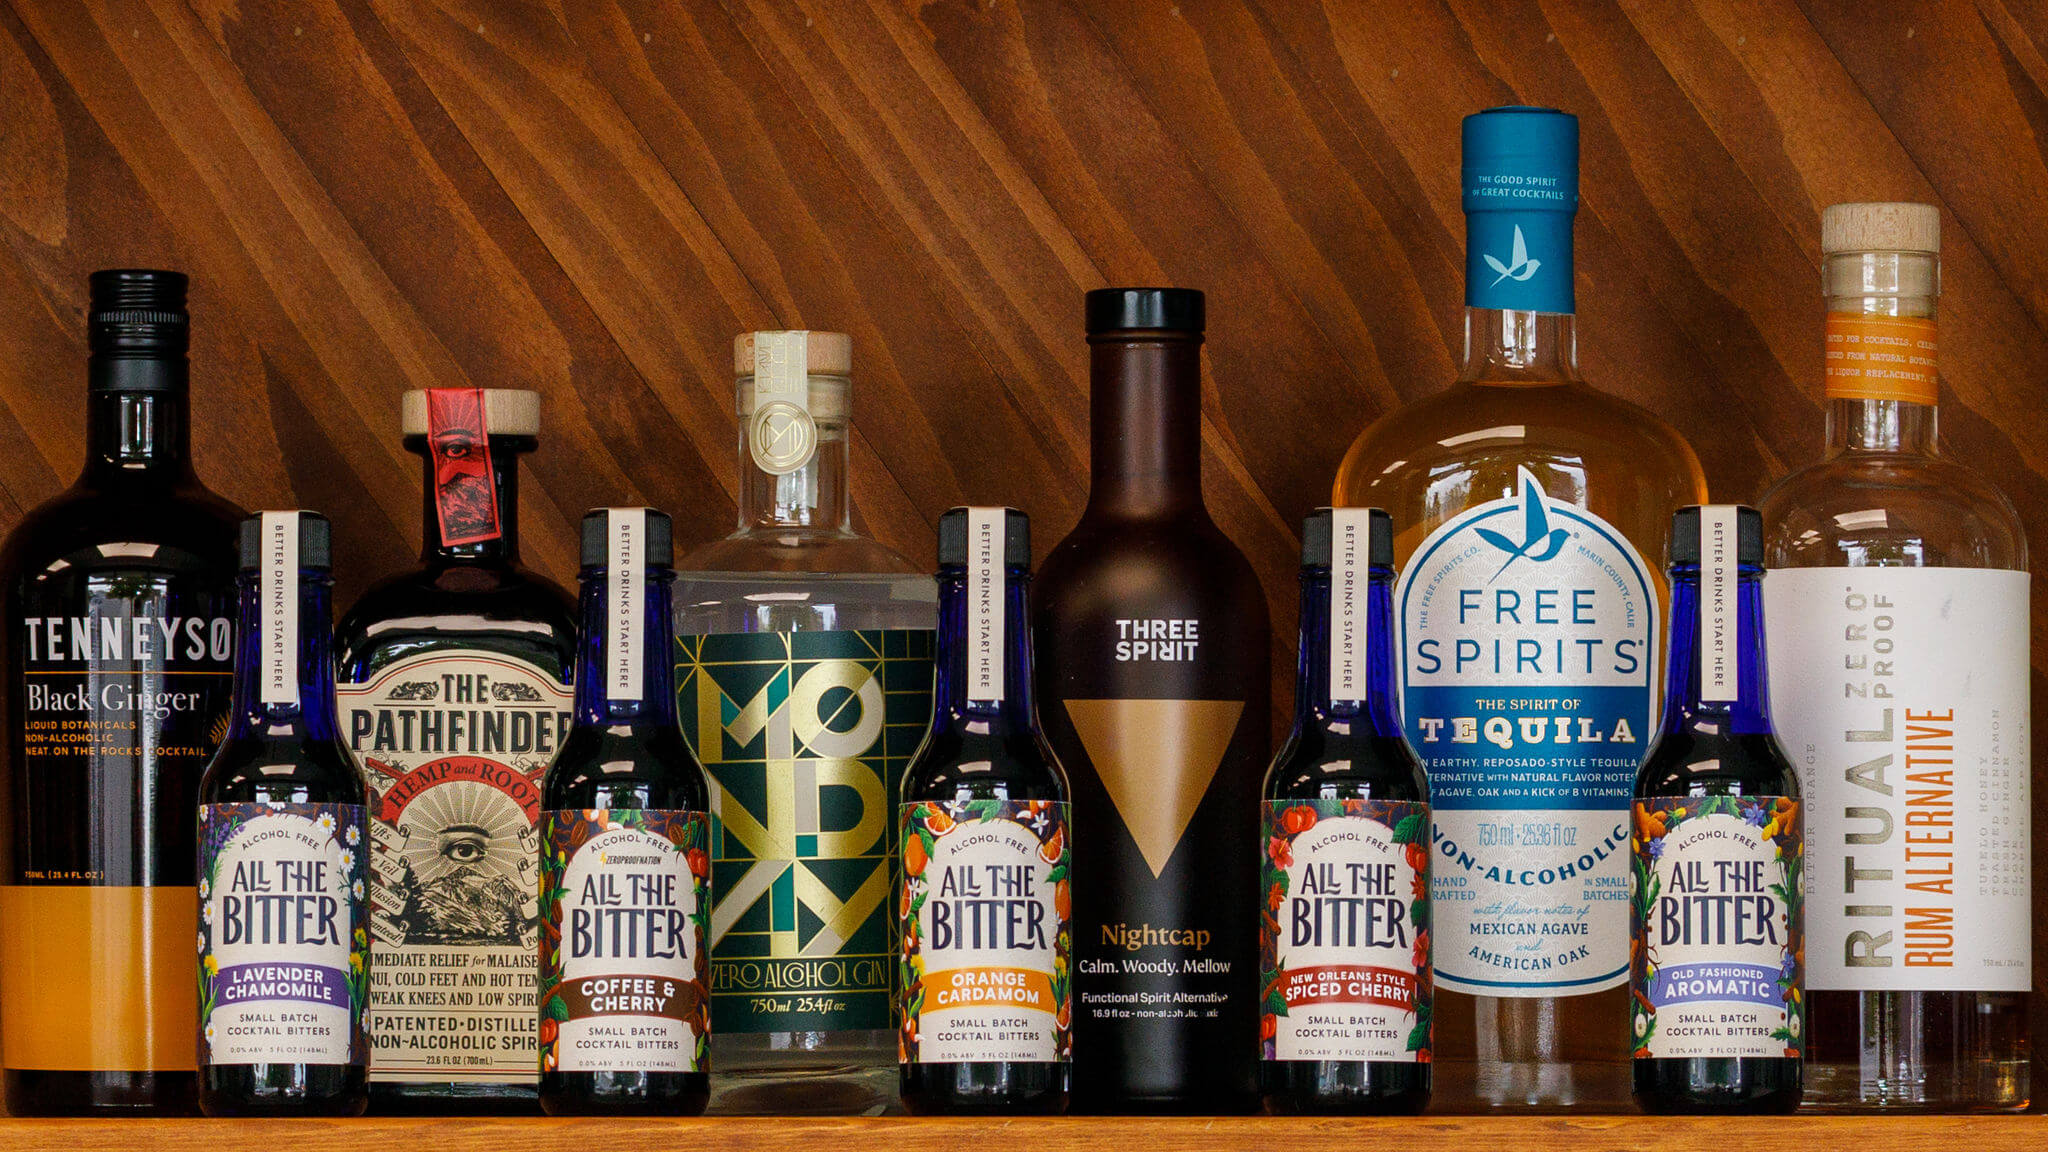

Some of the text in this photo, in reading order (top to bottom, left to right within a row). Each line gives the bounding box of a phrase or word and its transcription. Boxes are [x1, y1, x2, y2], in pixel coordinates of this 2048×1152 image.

[1494, 175, 1557, 186] GOOD SPIRIT
[1481, 188, 1564, 199] GREAT COCKTAILS
[273, 525, 284, 688] BETTER DRINKS START HERE
[619, 525, 630, 688] BETTER DRINKS START HERE
[980, 524, 991, 687] BETTER DRINKS START HERE
[1343, 526, 1354, 688] BETTER DRINKS START HERE
[1459, 589, 1596, 624] FREE
[1714, 523, 1724, 686] BETTER DRINKS START HERE
[1116, 620, 1199, 639] THREE
[1115, 641, 1199, 661] SPIRIT
[1873, 593, 1894, 699] PROOF
[1416, 638, 1639, 674] SPIRITS
[441, 673, 489, 704] THE
[28, 684, 200, 720] Black Ginger
[1476, 699, 1581, 710] THE SPIRIT OF
[62, 721, 136, 730] BOTANICALS
[1418, 717, 1636, 749] TEQUILA
[25, 734, 113, 743] NON-ALCOHOLIC
[1483, 758, 1586, 767] REPOSADO-STYLE
[387, 761, 451, 809] HEMP
[1511, 773, 1601, 782] NATURAL FLAVOR
[1478, 788, 1630, 797] OAK KICK VITAMINS
[1991, 709, 2000, 896] TOASTED CINNAMON
[1979, 756, 1988, 895] TUPELO HONEY
[242, 831, 320, 850] ALCOHOL FREE
[591, 835, 670, 854] ALCOHOL FREE
[951, 834, 1028, 856] ALCOHOL FREE
[1311, 833, 1389, 853] ALCOHOL FREE
[1678, 830, 1758, 851] ALCOHOL FREE
[1844, 708, 1894, 968] RITUAL
[1903, 707, 1954, 968] RUM ALTERNATIVE
[232, 861, 327, 893] ALL THE
[940, 865, 1035, 897] ALL THE
[1300, 863, 1396, 895] ALL THE
[1595, 878, 1628, 887] SMALL
[1669, 861, 1764, 893] ALL THE
[580, 874, 676, 906] ALL THE
[1583, 890, 1629, 900] BATCHES
[223, 895, 340, 945] BITTER
[932, 900, 1047, 949] BITTER
[1292, 898, 1407, 948] BITTER
[1470, 923, 1588, 935] MEXICAN AGAVE
[1660, 896, 1778, 945] BITTER
[572, 909, 687, 959] BITTER
[1101, 923, 1211, 951] Nightcap
[430, 953, 469, 967] RELIEF
[1469, 945, 1590, 970] AMERICAN OAK
[232, 967, 323, 984] LAVENDER
[711, 960, 886, 990] ZERO ALCOHOL GIN
[1079, 959, 1231, 976] Calm. Woody. Mellow
[1672, 968, 1763, 980] OLD FASHIONED
[395, 973, 514, 987] COLD FEET AND HOT
[581, 979, 675, 997] COFFEE &
[951, 972, 1026, 987] ORANGE
[1290, 971, 1406, 986] NEW ORLEANS STYLE
[225, 983, 332, 1000] CHAMOMILE
[371, 992, 504, 1006] WEAK KNEES AND LOW
[937, 988, 1039, 1004] CARDAMOM
[1082, 992, 1170, 1005] Functional Spirit
[1286, 983, 1409, 1002] SPICED CHERRY
[1665, 980, 1770, 999] AROMATIC
[591, 996, 666, 1012] CHERRY
[239, 1014, 318, 1022] SMALL BATCH
[950, 1019, 1028, 1028] SMALL BATCH
[1308, 1016, 1386, 1025] SMALL BATCH
[1678, 1014, 1757, 1023] SMALL BATCH
[227, 1027, 330, 1036] COCKTAIL BITTERS
[588, 1027, 667, 1036] SMALL BATCH
[937, 1032, 1039, 1041] COCKTAIL BITTERS
[1296, 1029, 1398, 1039] COCKTAIL BITTERS
[1667, 1028, 1769, 1036] COCKTAIL BITTERS
[576, 1041, 679, 1050] COCKTAIL BITTERS
[463, 1056, 492, 1065] (700mL)
